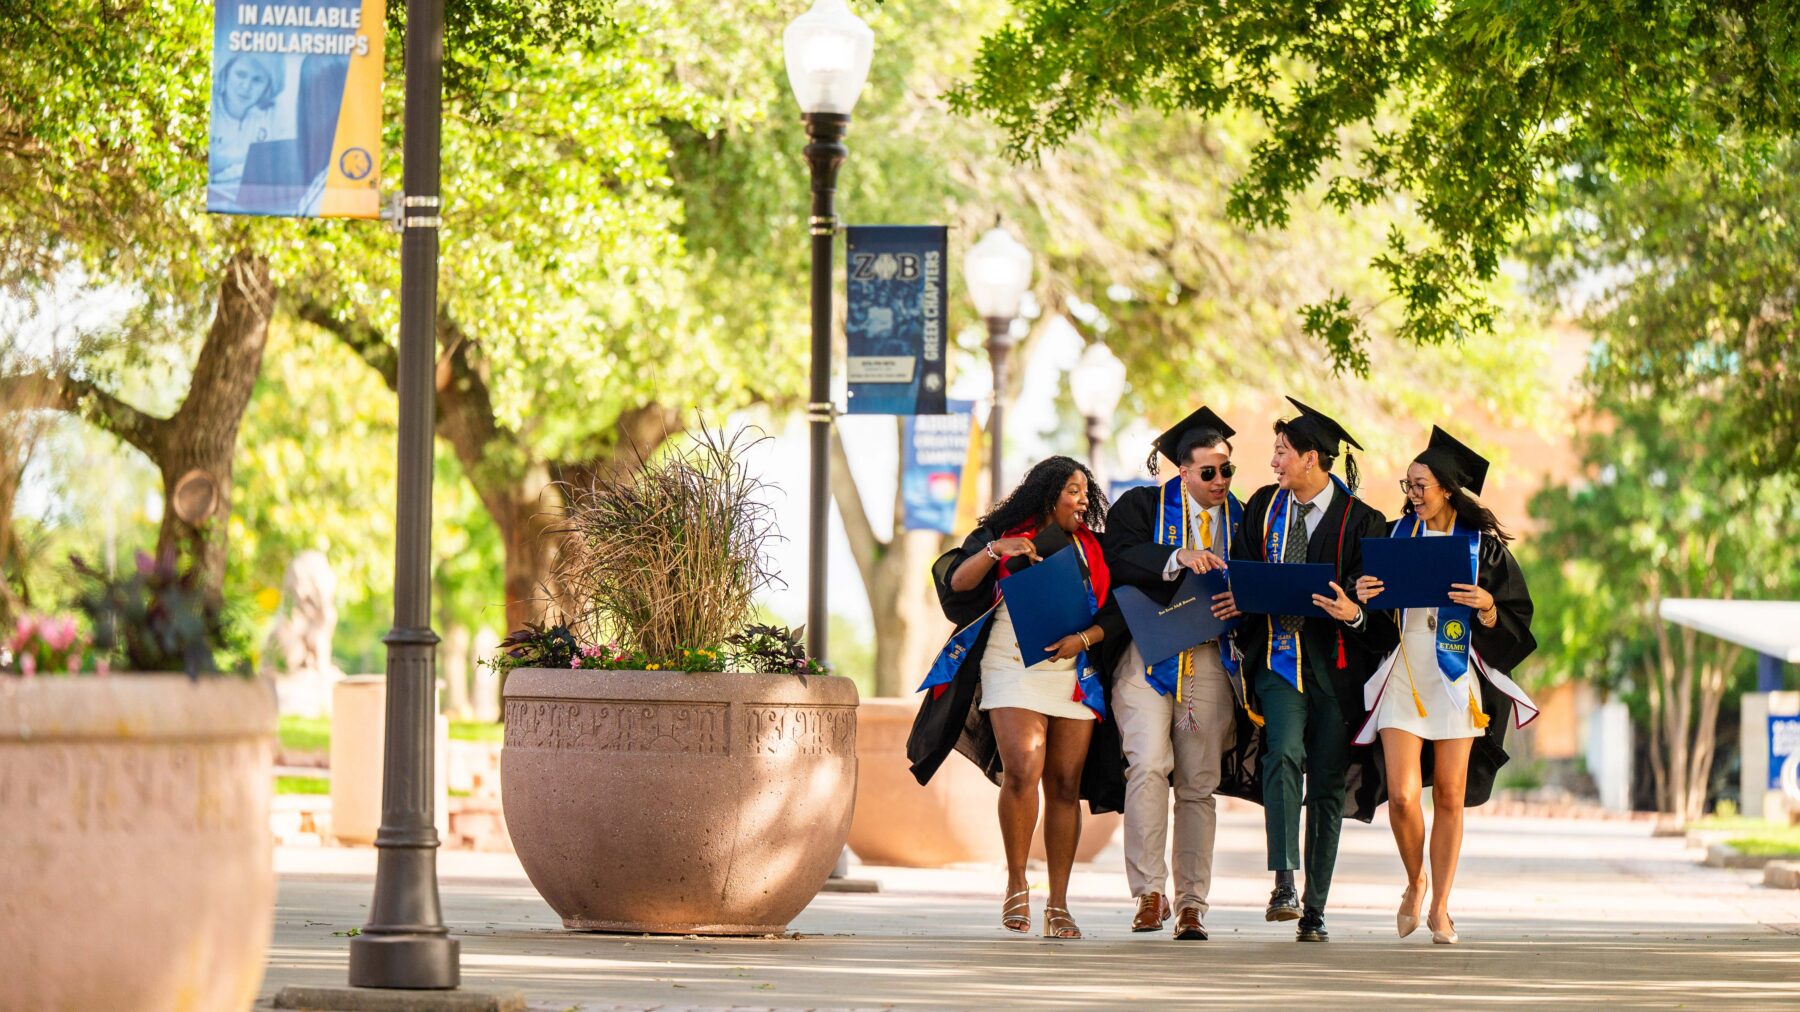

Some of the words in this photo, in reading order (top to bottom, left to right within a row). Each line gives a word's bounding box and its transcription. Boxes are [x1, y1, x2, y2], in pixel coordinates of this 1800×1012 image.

[238, 4, 258, 25] IN
[261, 5, 361, 28] AVAILABLE
[229, 30, 368, 55] SCHOLARSHIPS
[1440, 642, 1466, 650] ETAMU
